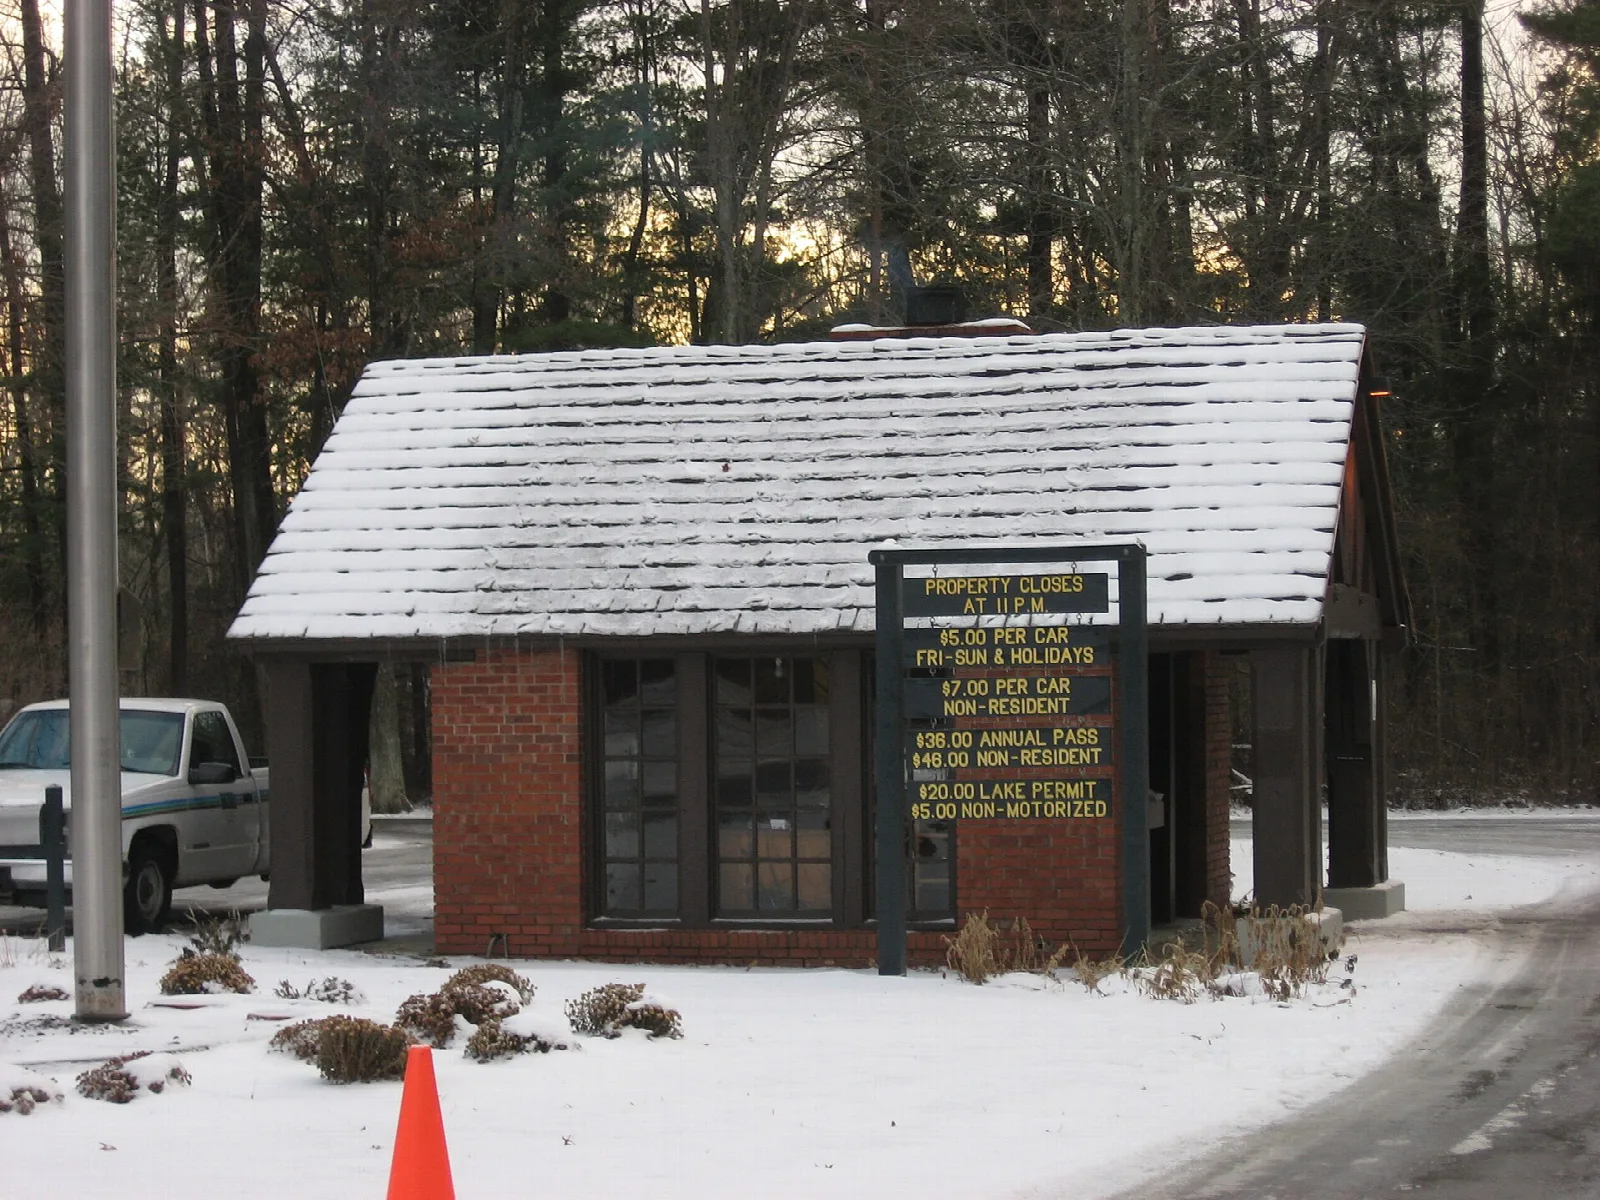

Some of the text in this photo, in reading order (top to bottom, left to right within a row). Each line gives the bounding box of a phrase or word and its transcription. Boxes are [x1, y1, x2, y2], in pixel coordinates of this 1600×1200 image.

[926, 576, 1083, 595] PROPERTY CLOSES
[964, 598, 987, 614] AT
[940, 627, 1068, 646] $5.00 PER CAR
[917, 647, 1094, 666] FRI-SUN & HOLIDAYS
[942, 678, 1070, 697] $7.00 PER CAR
[944, 698, 1069, 716] NON-RESIDENT
[916, 729, 1098, 749] $36.00 ANNUAL PASS
[912, 748, 1102, 768] $46.00 NON-RESIDENT
[919, 782, 1096, 800] $20.00 LAKE PERMIT
[911, 800, 1107, 819] $5.00 NON-MOTORIZED
